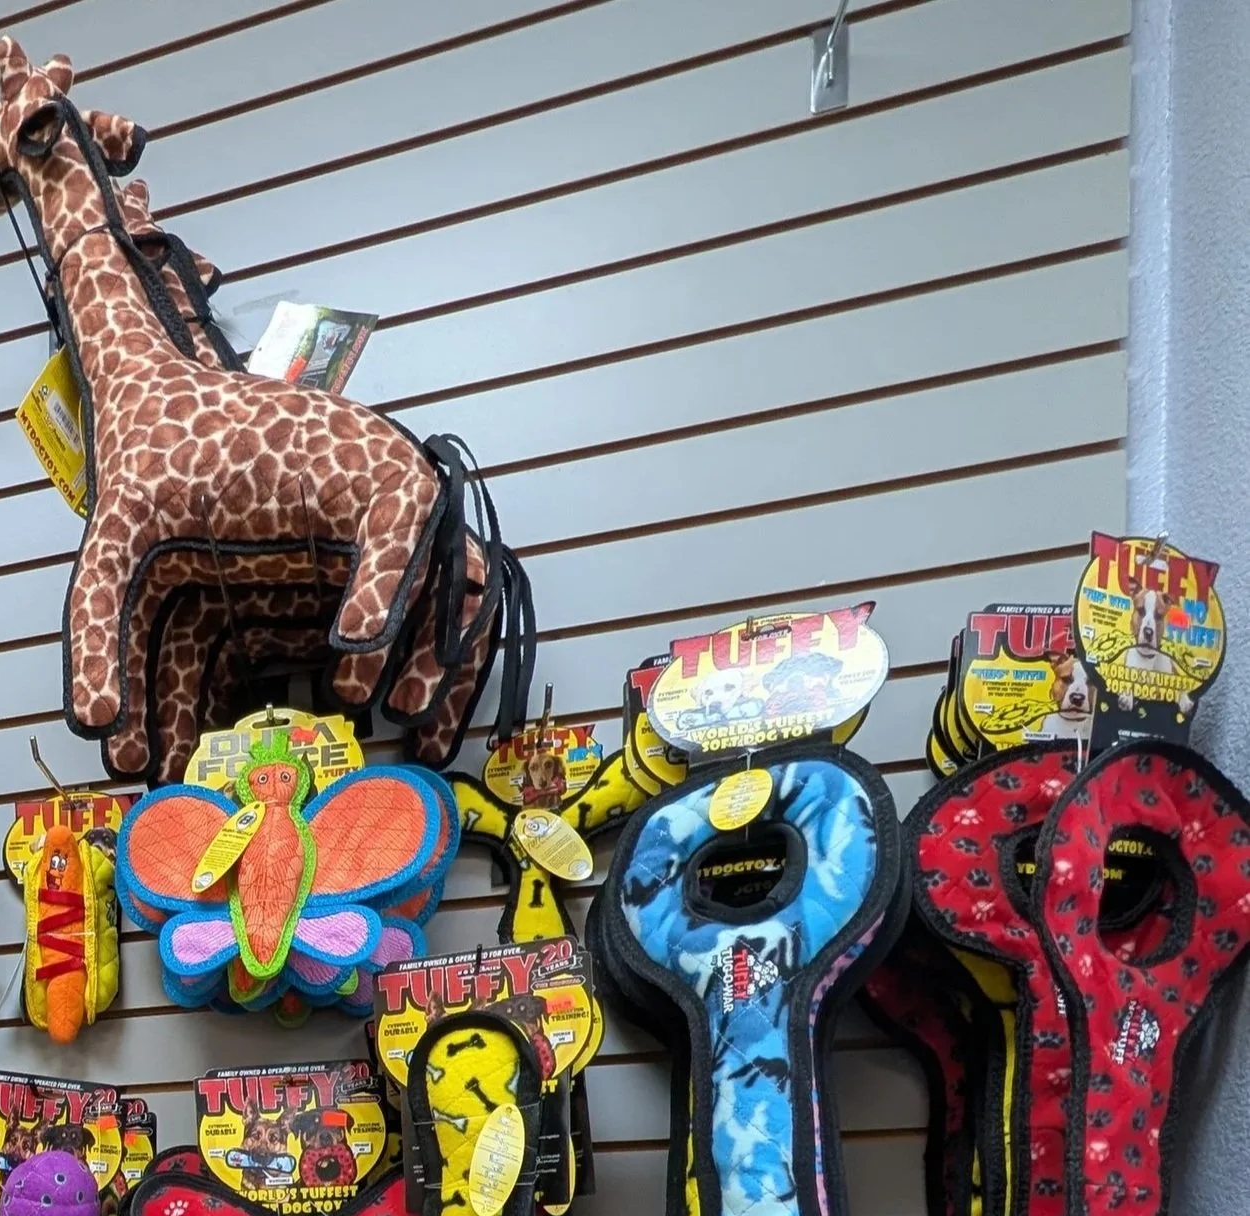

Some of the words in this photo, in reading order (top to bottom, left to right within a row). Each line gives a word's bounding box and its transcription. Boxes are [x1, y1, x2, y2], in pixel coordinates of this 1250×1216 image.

[20, 410, 76, 503] MYDOGTOY.COM
[1091, 531, 1219, 602] TUFFY
[996, 605, 1024, 615] FAMILY
[1024, 606, 1053, 615] OWNED
[670, 601, 877, 680] TUFFY
[970, 613, 1075, 657] TUF
[1100, 662, 1149, 685] WORLD'S
[1150, 670, 1196, 690] TUFFEST
[1105, 677, 1134, 696] SOFT
[1134, 682, 1158, 700] DOG
[689, 718, 763, 743] WORLD'S
[765, 710, 836, 732] TUFFEST
[701, 735, 744, 753] SOFT
[746, 731, 779, 748] DOG
[781, 721, 817, 742] TOY
[492, 724, 596, 763] TUFY
[198, 742, 349, 782] FOCE
[323, 765, 360, 779] TUFFY
[399, 961, 423, 971] FAMILY
[423, 957, 448, 968] OWNED
[455, 952, 487, 964] OPERAED
[487, 951, 503, 960] FOR
[541, 939, 573, 964] 20
[545, 960, 570, 972] YEARS
[733, 947, 751, 1002] TUFFY
[377, 953, 538, 1012] TUFFY
[551, 1009, 590, 1023] TRAINING!
[384, 1026, 419, 1037] DURABLE
[1110, 1020, 1131, 1065] STUFF
[342, 1063, 370, 1081] 20
[93, 1088, 117, 1105] 20
[198, 1072, 341, 1113] TUFFY
[300, 1185, 359, 1200] TUFFEST
[282, 1202, 312, 1215] DOG
[313, 1199, 343, 1213] TOY
